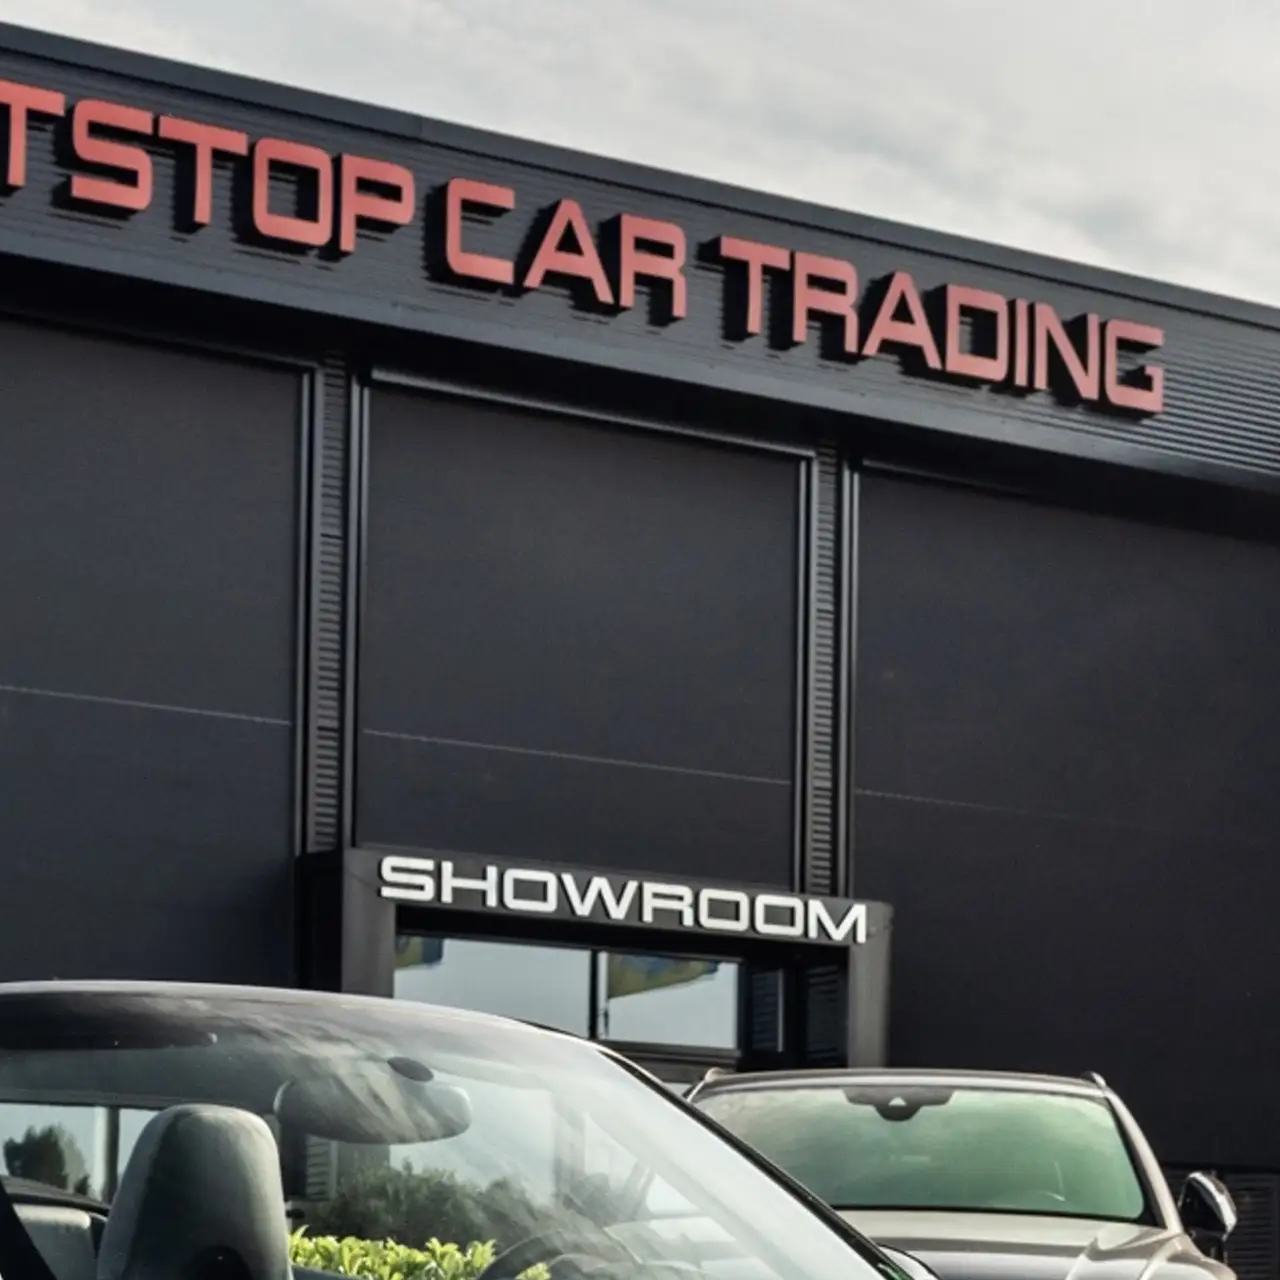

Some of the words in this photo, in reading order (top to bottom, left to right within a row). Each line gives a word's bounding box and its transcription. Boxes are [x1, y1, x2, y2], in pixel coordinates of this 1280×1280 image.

[445, 176, 687, 320] CAR
[720, 234, 1165, 414] TRADING
[380, 855, 867, 945] SHOWROOM
